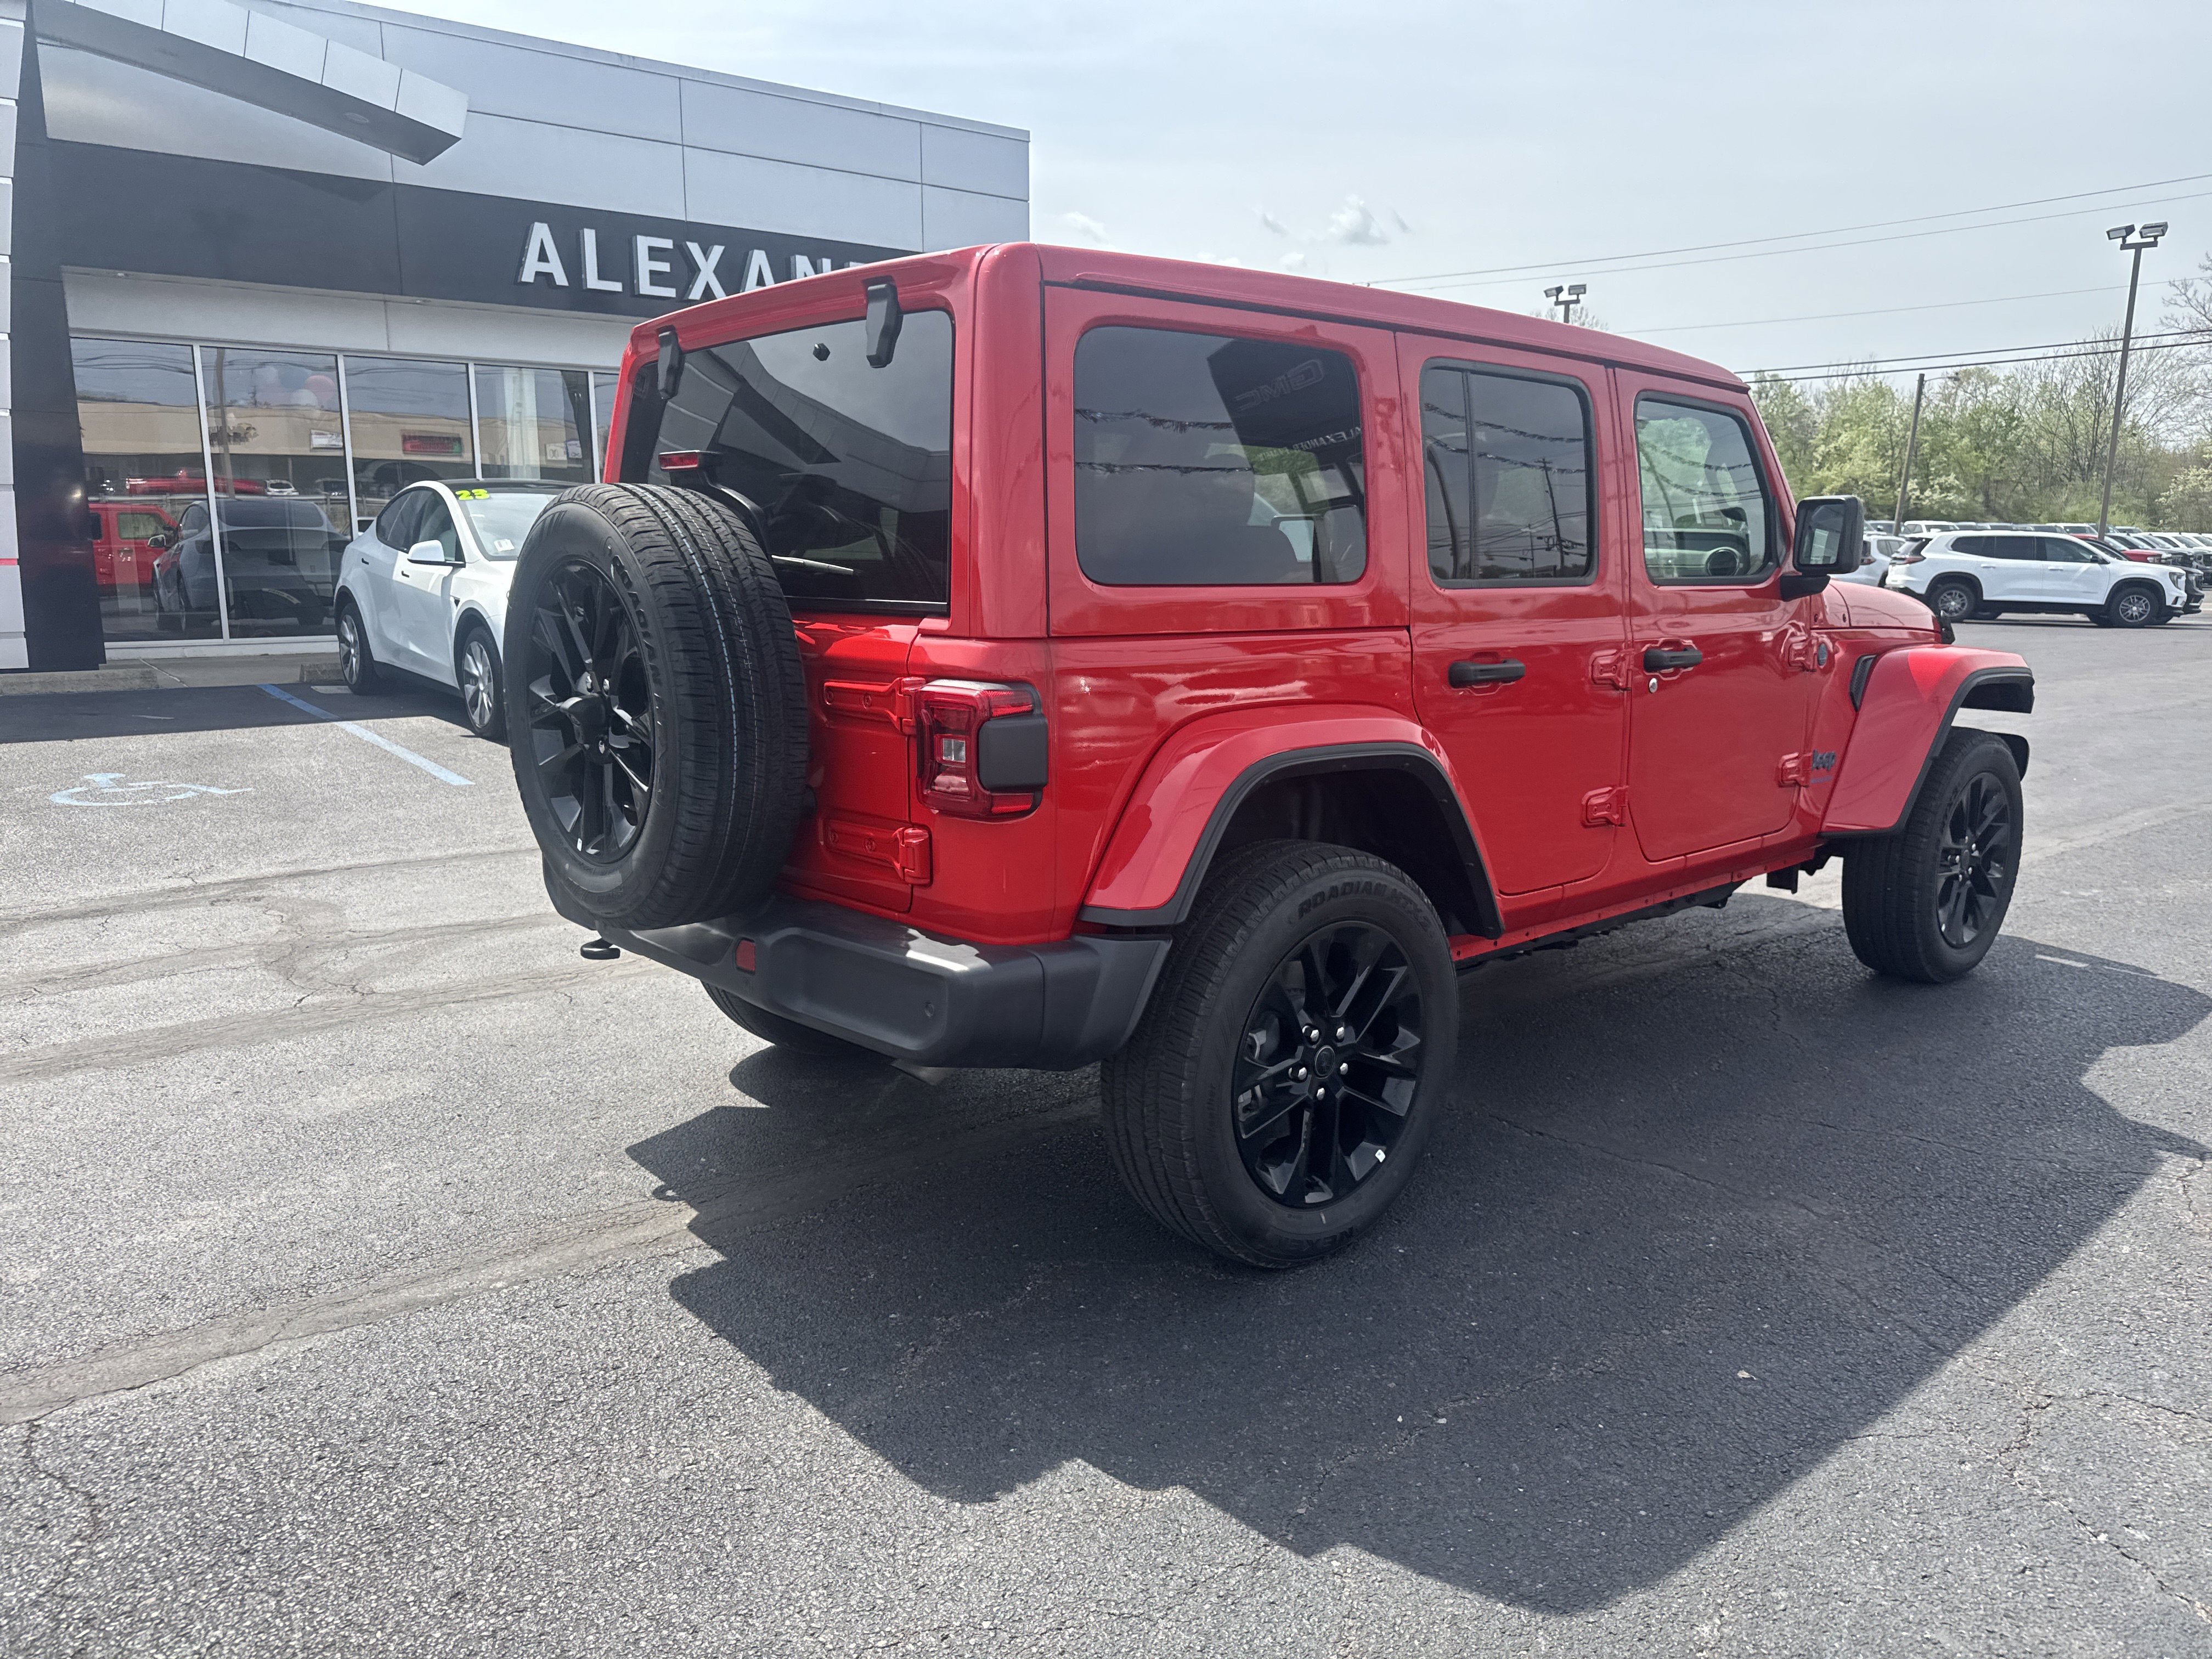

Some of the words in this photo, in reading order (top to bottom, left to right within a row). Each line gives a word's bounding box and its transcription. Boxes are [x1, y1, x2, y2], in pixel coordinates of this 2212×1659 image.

[517, 222, 866, 301] ALEXA
[455, 488, 490, 500] 23
[1297, 881, 1387, 919] ROADIAN
